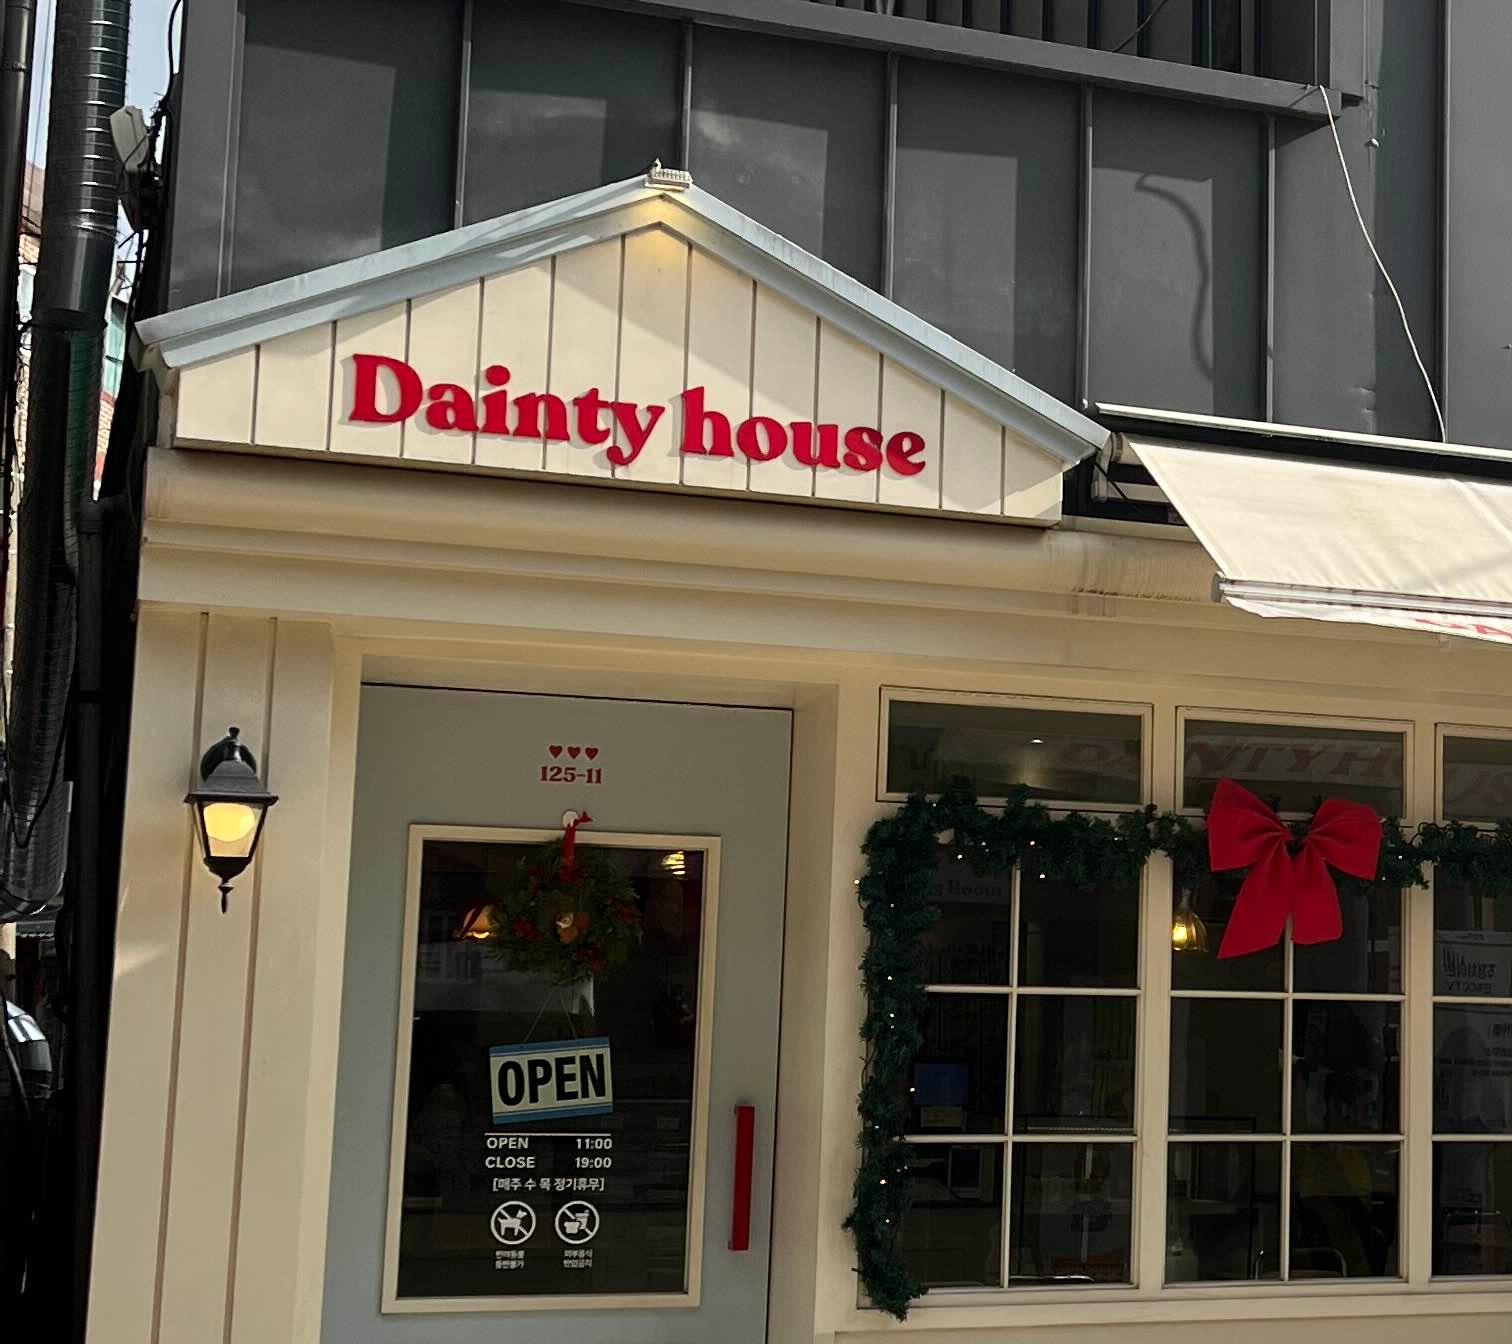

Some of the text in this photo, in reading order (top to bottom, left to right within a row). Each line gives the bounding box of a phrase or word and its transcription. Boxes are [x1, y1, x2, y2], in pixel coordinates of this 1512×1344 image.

[350, 353, 926, 477] Dainty house
[540, 765, 602, 784] 125-11
[497, 1053, 606, 1107] OPEN
[486, 1137, 613, 1150] OPEN 11:00
[485, 1156, 612, 1168] CLOSE 19:00
[524, 1177, 537, 1191] 수
[539, 1177, 551, 1191] 목
